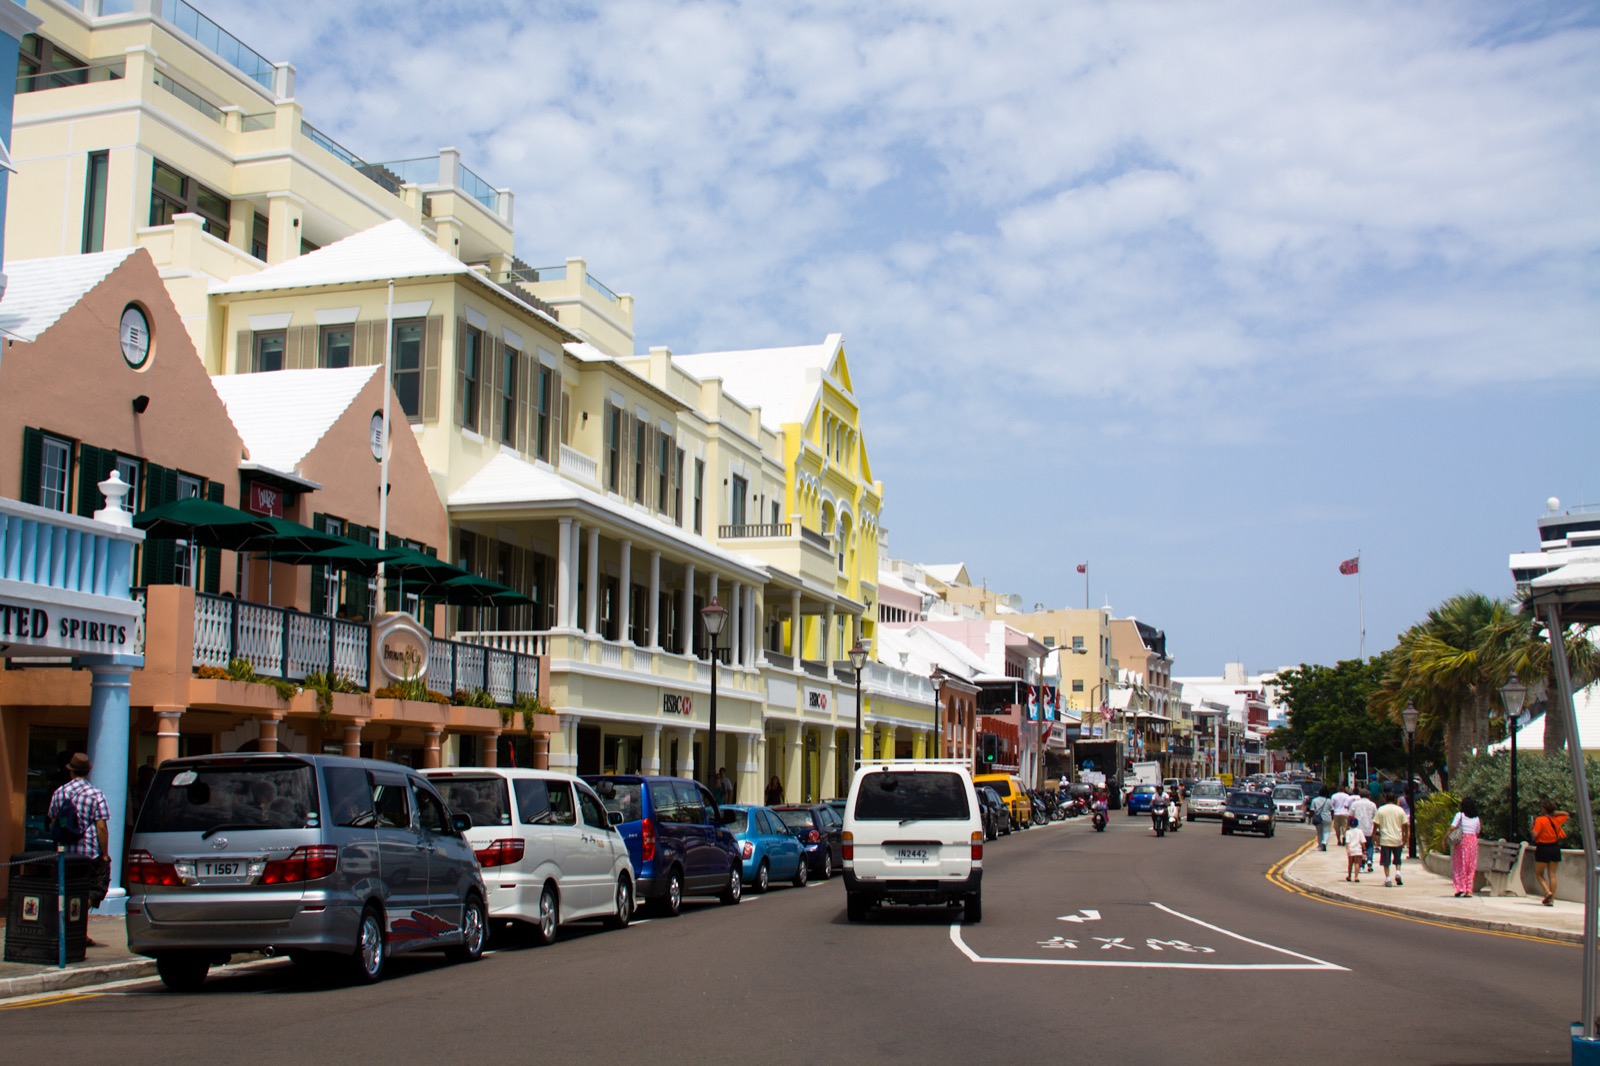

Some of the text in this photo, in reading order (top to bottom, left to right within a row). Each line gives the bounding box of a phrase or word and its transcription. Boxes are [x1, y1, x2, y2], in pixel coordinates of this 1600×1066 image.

[0, 603, 126, 645] TED SPIRITS
[663, 693, 682, 714] HSBC
[809, 691, 821, 708] HSBC
